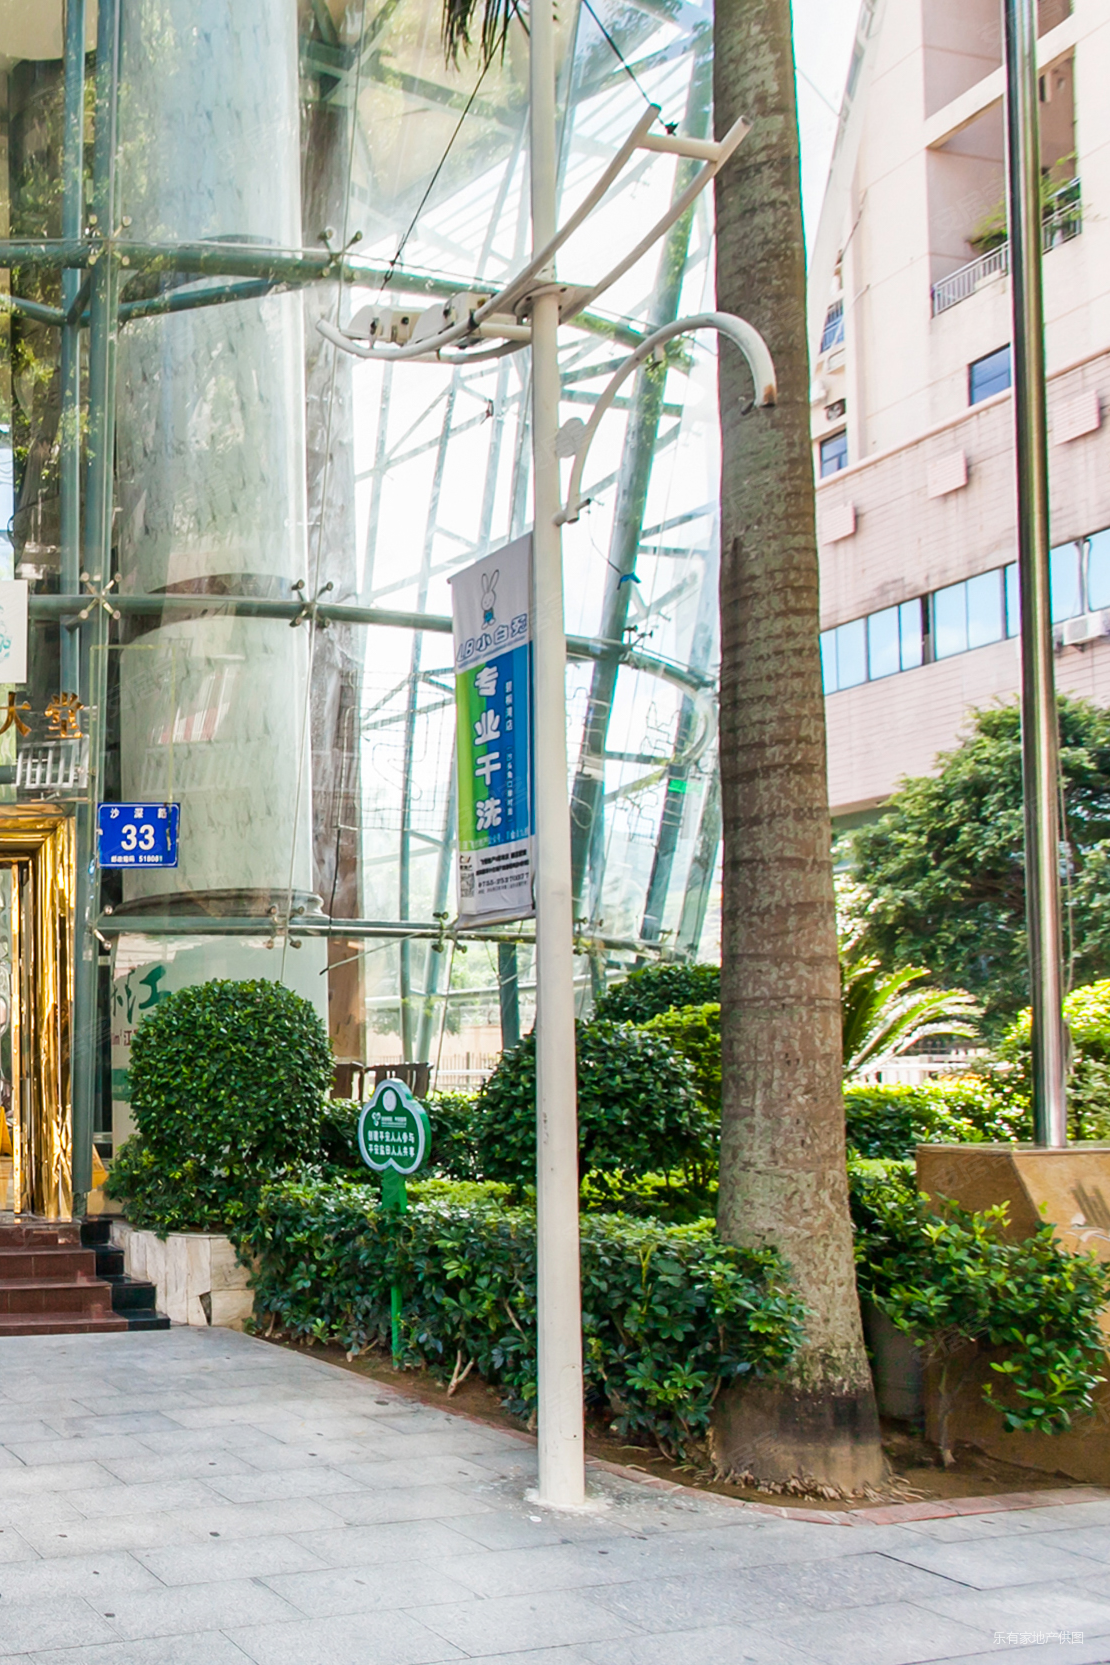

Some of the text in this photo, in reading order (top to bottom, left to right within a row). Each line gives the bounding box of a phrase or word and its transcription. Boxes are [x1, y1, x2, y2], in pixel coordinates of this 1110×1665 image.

[474, 665, 502, 833] 专业干洗
[121, 823, 155, 851] 33
